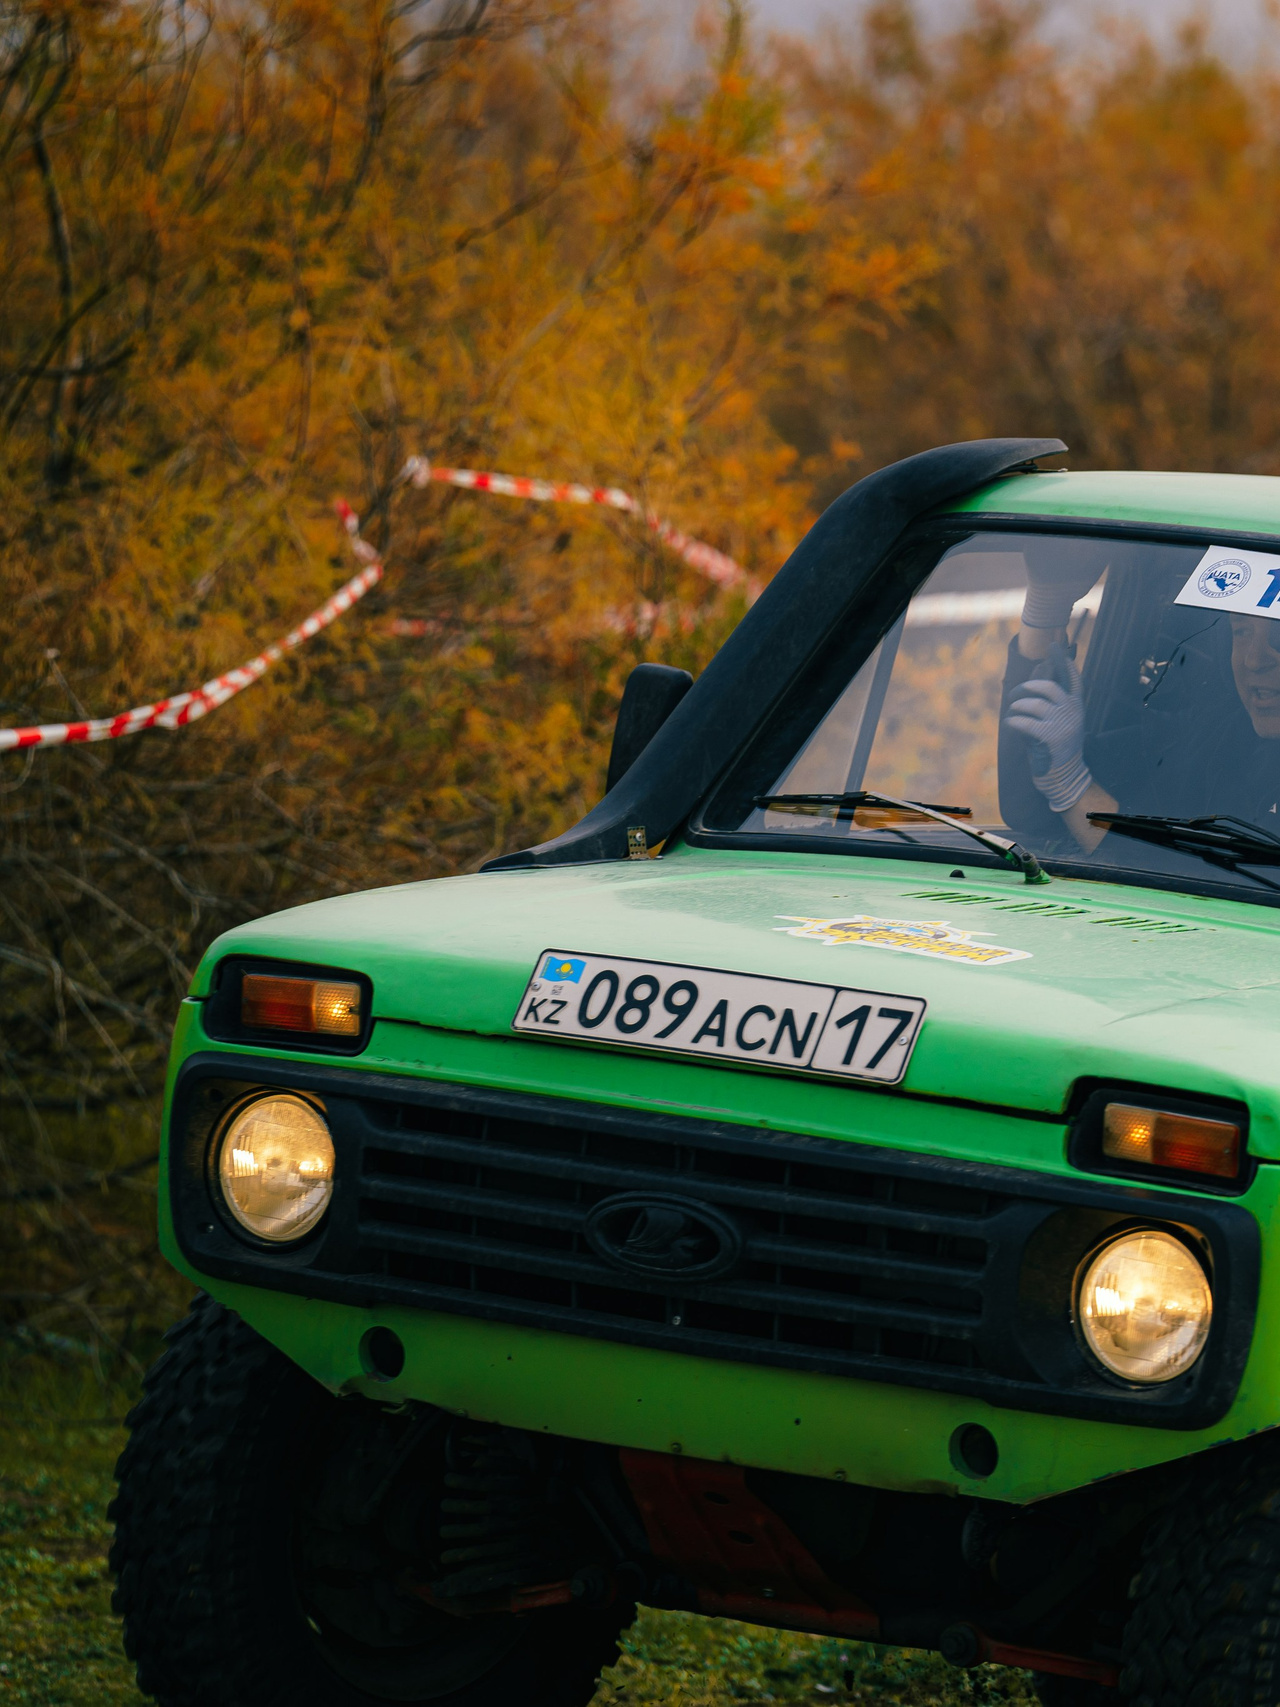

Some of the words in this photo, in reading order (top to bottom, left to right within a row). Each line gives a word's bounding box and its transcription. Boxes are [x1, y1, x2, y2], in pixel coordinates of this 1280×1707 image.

[1213, 570, 1241, 581] UATA
[522, 997, 569, 1026] KZ
[834, 1003, 915, 1070] 17
